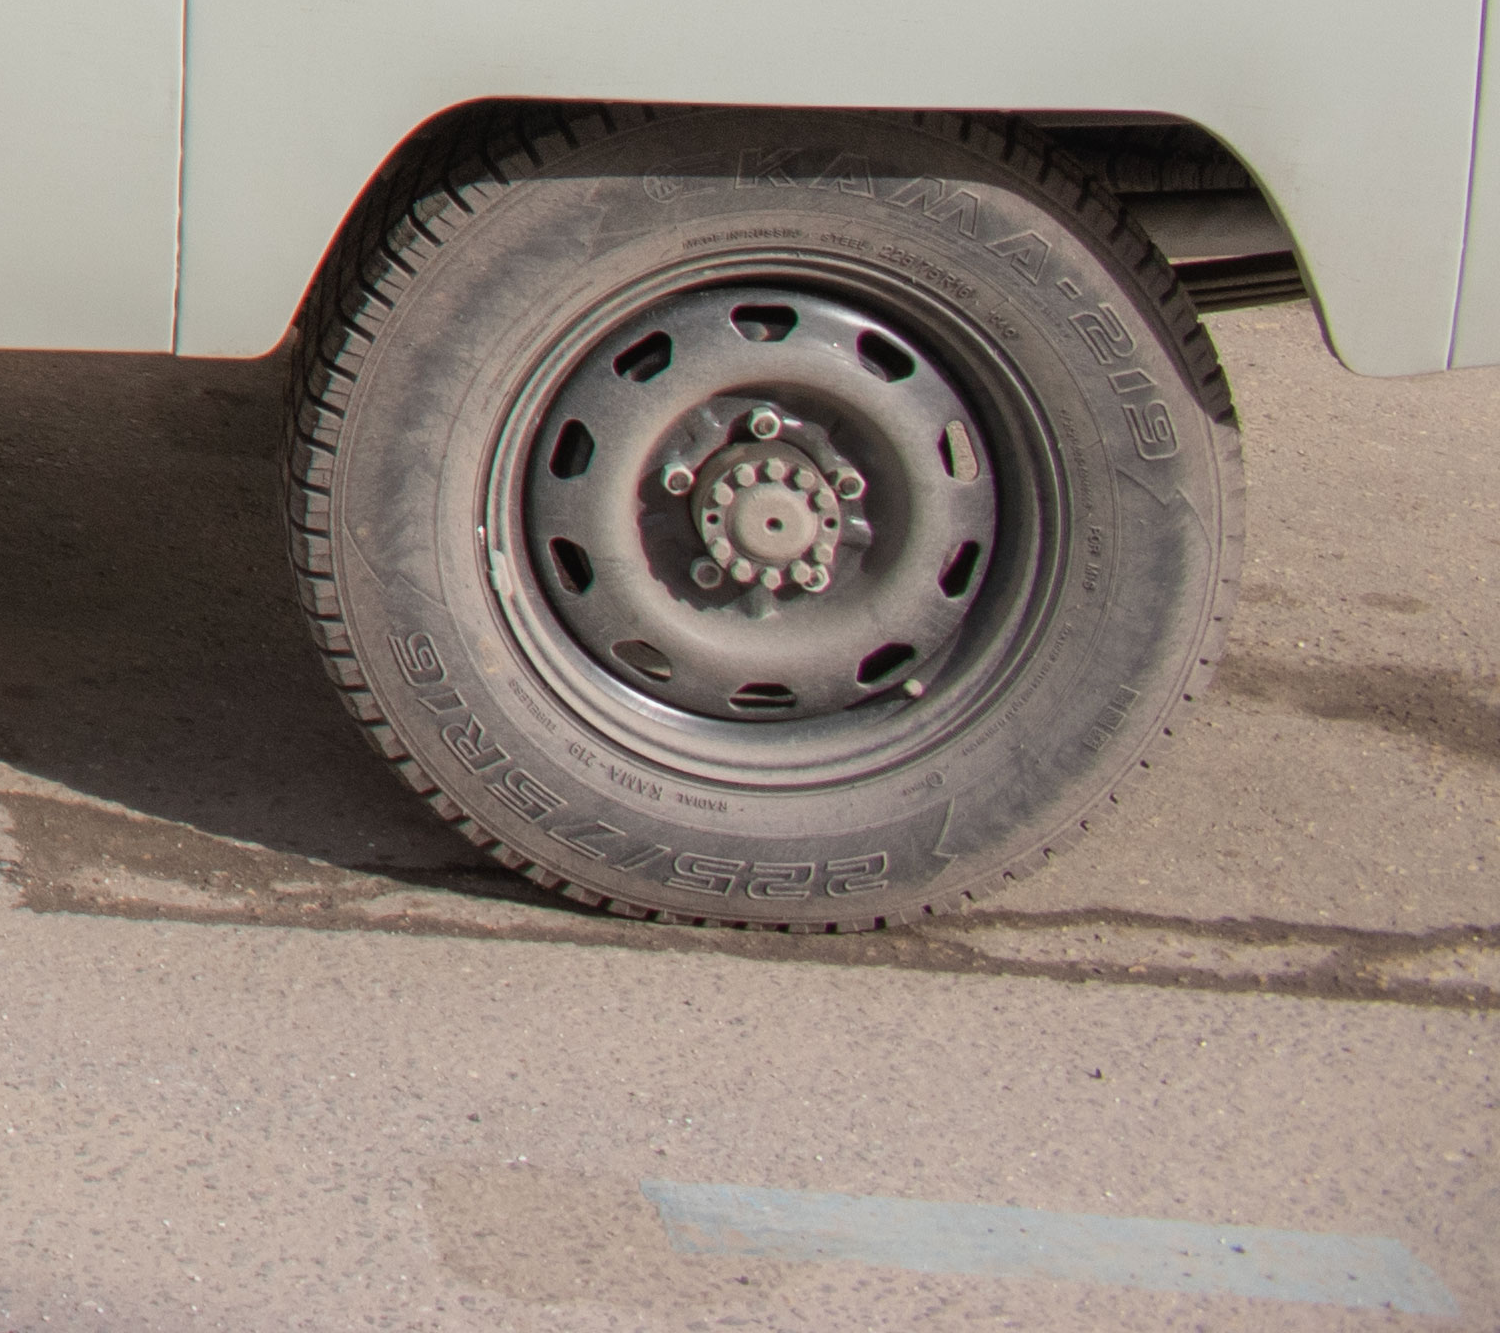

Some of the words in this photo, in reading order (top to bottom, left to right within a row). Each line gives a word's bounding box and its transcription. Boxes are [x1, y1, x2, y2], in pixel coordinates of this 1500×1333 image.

[734, 147, 1180, 461] KAMA-219
[386, 631, 891, 901] 225/75R16
[675, 792, 729, 813] RADIAL
